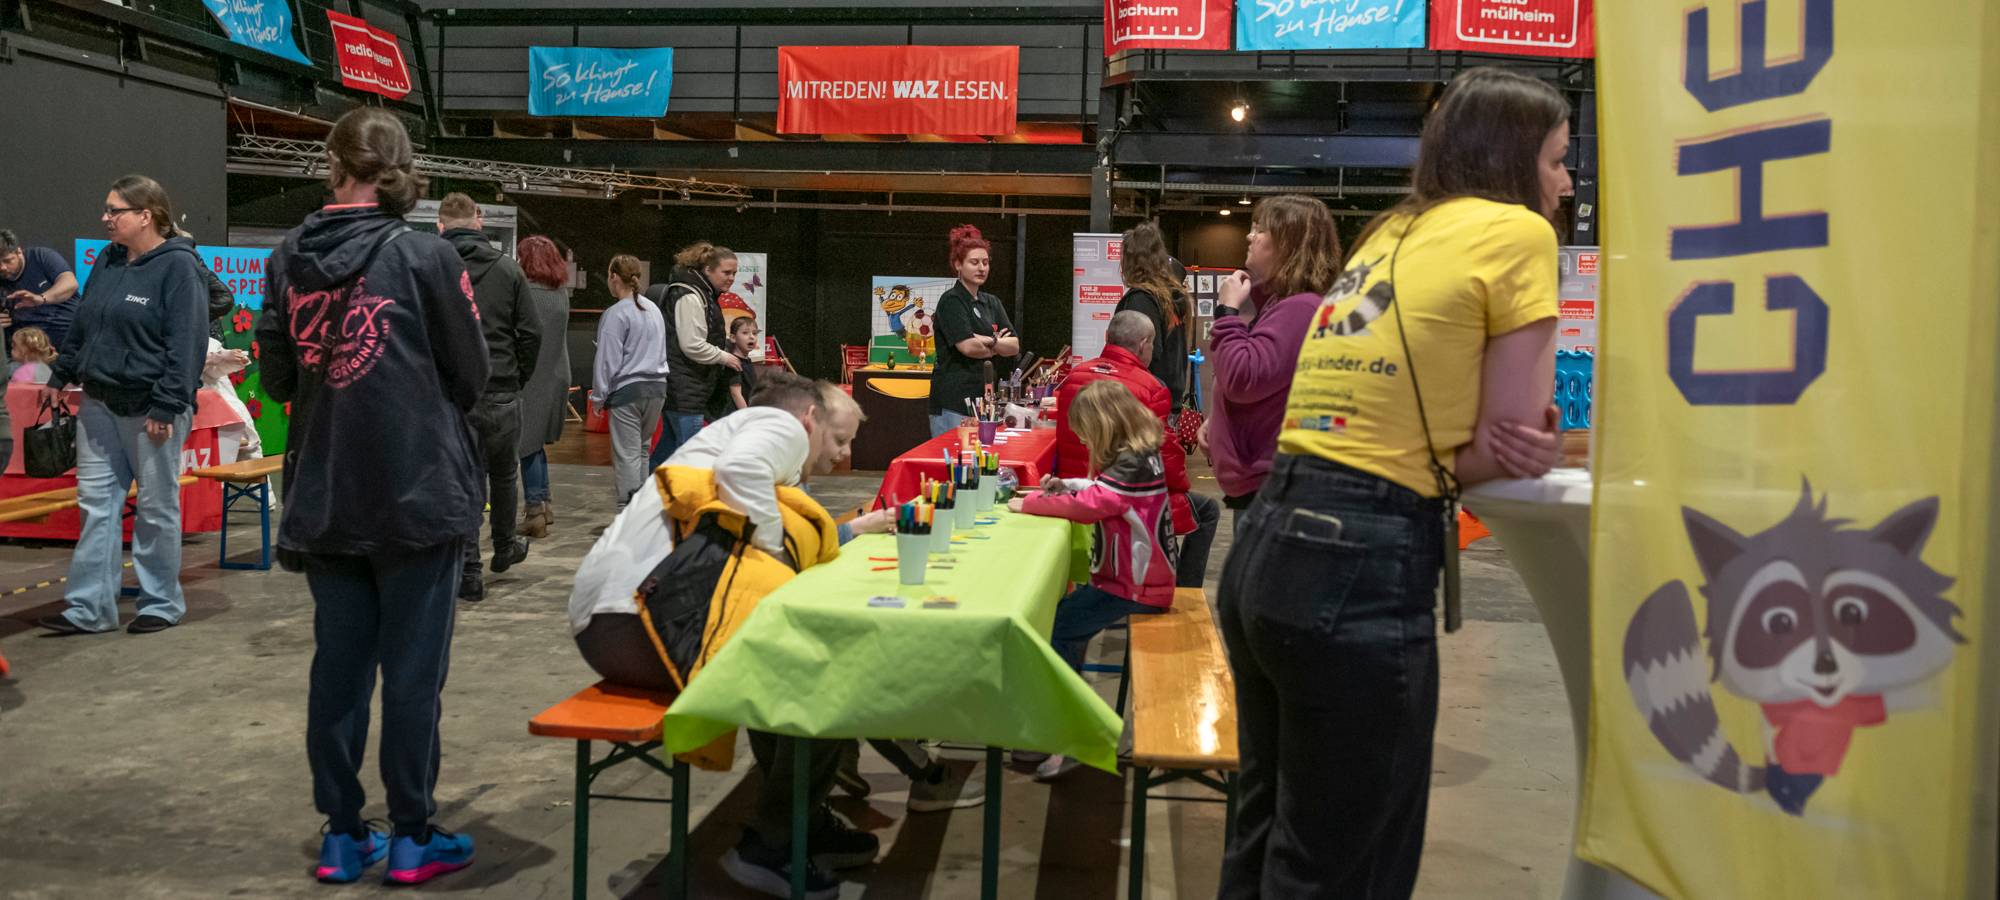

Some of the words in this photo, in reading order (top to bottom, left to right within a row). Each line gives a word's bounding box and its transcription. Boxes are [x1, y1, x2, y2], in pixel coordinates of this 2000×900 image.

[1480, 6, 1555, 23] mülheim
[1274, 21, 1304, 38] zu
[345, 42, 373, 59] radio
[543, 63, 571, 92] So
[575, 59, 639, 89] klingt
[555, 91, 576, 106] zu
[578, 70, 658, 105] Hause!
[786, 80, 887, 99] MITREDEN!
[892, 80, 940, 99] WAZ
[944, 80, 1009, 100] LESEN.
[332, 332, 379, 380] ORIGINAL
